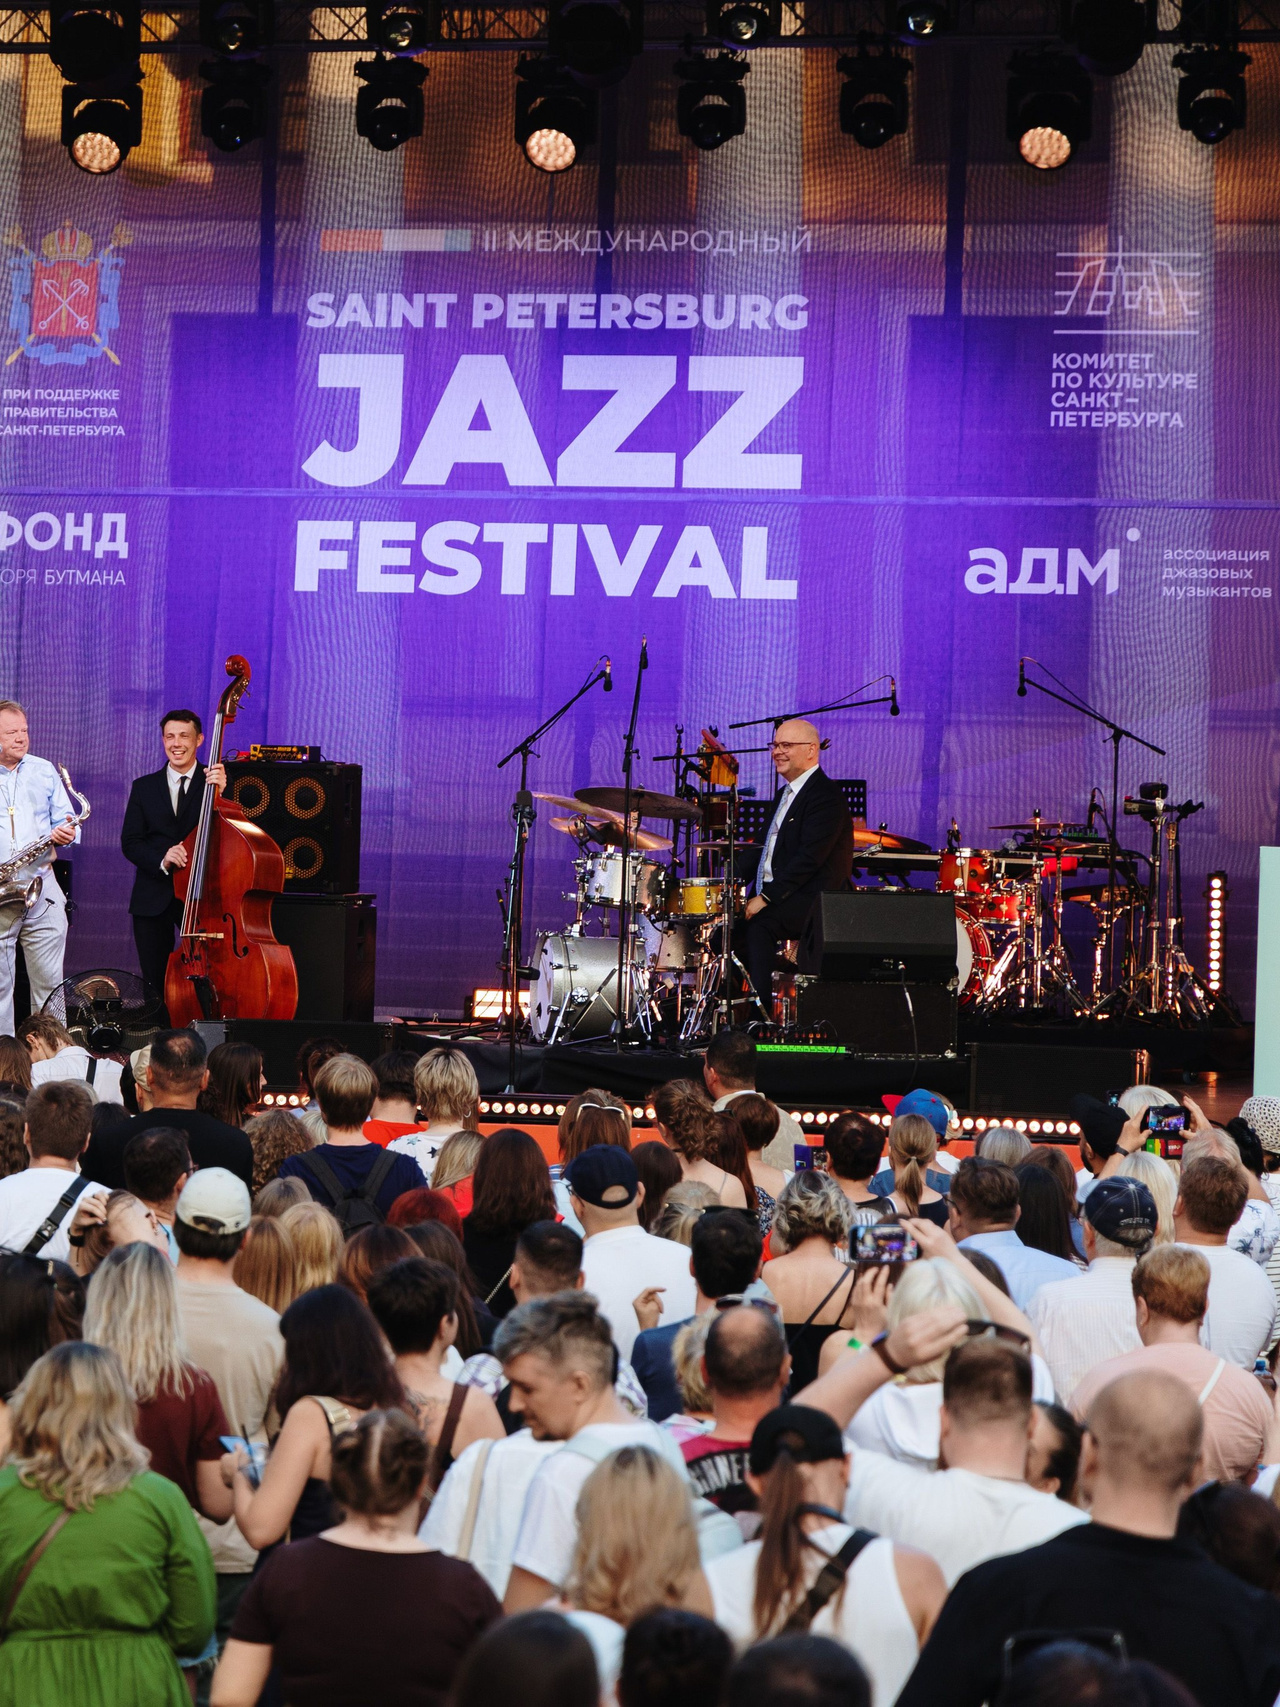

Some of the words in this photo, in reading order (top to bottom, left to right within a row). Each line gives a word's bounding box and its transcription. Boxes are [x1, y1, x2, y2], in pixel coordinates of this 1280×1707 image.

[508, 225, 812, 256] МЕЖДУНАРОДНЫЙ
[306, 292, 457, 328] SAINT
[472, 293, 809, 330] PETERSBURG
[1052, 353, 1154, 369] КОМИТЕТ
[1051, 373, 1083, 389] ПО
[1089, 373, 1198, 390] КУЛЬТУРЕ
[3, 389, 31, 400] ПРИ
[34, 389, 120, 402] ПОДДЕРЖКЕ
[3, 407, 118, 418] ПРАВИТЕЛЬСТВА
[1050, 412, 1184, 428] ПЕТЕРБУРГА
[301, 353, 805, 490] JAZZ
[294, 520, 798, 600] FESTIVAL
[1163, 549, 1270, 562] ассоциация
[44, 569, 126, 586] БУТМАНА
[1162, 567, 1253, 580] джазовых
[1162, 585, 1272, 599] музыкантов
